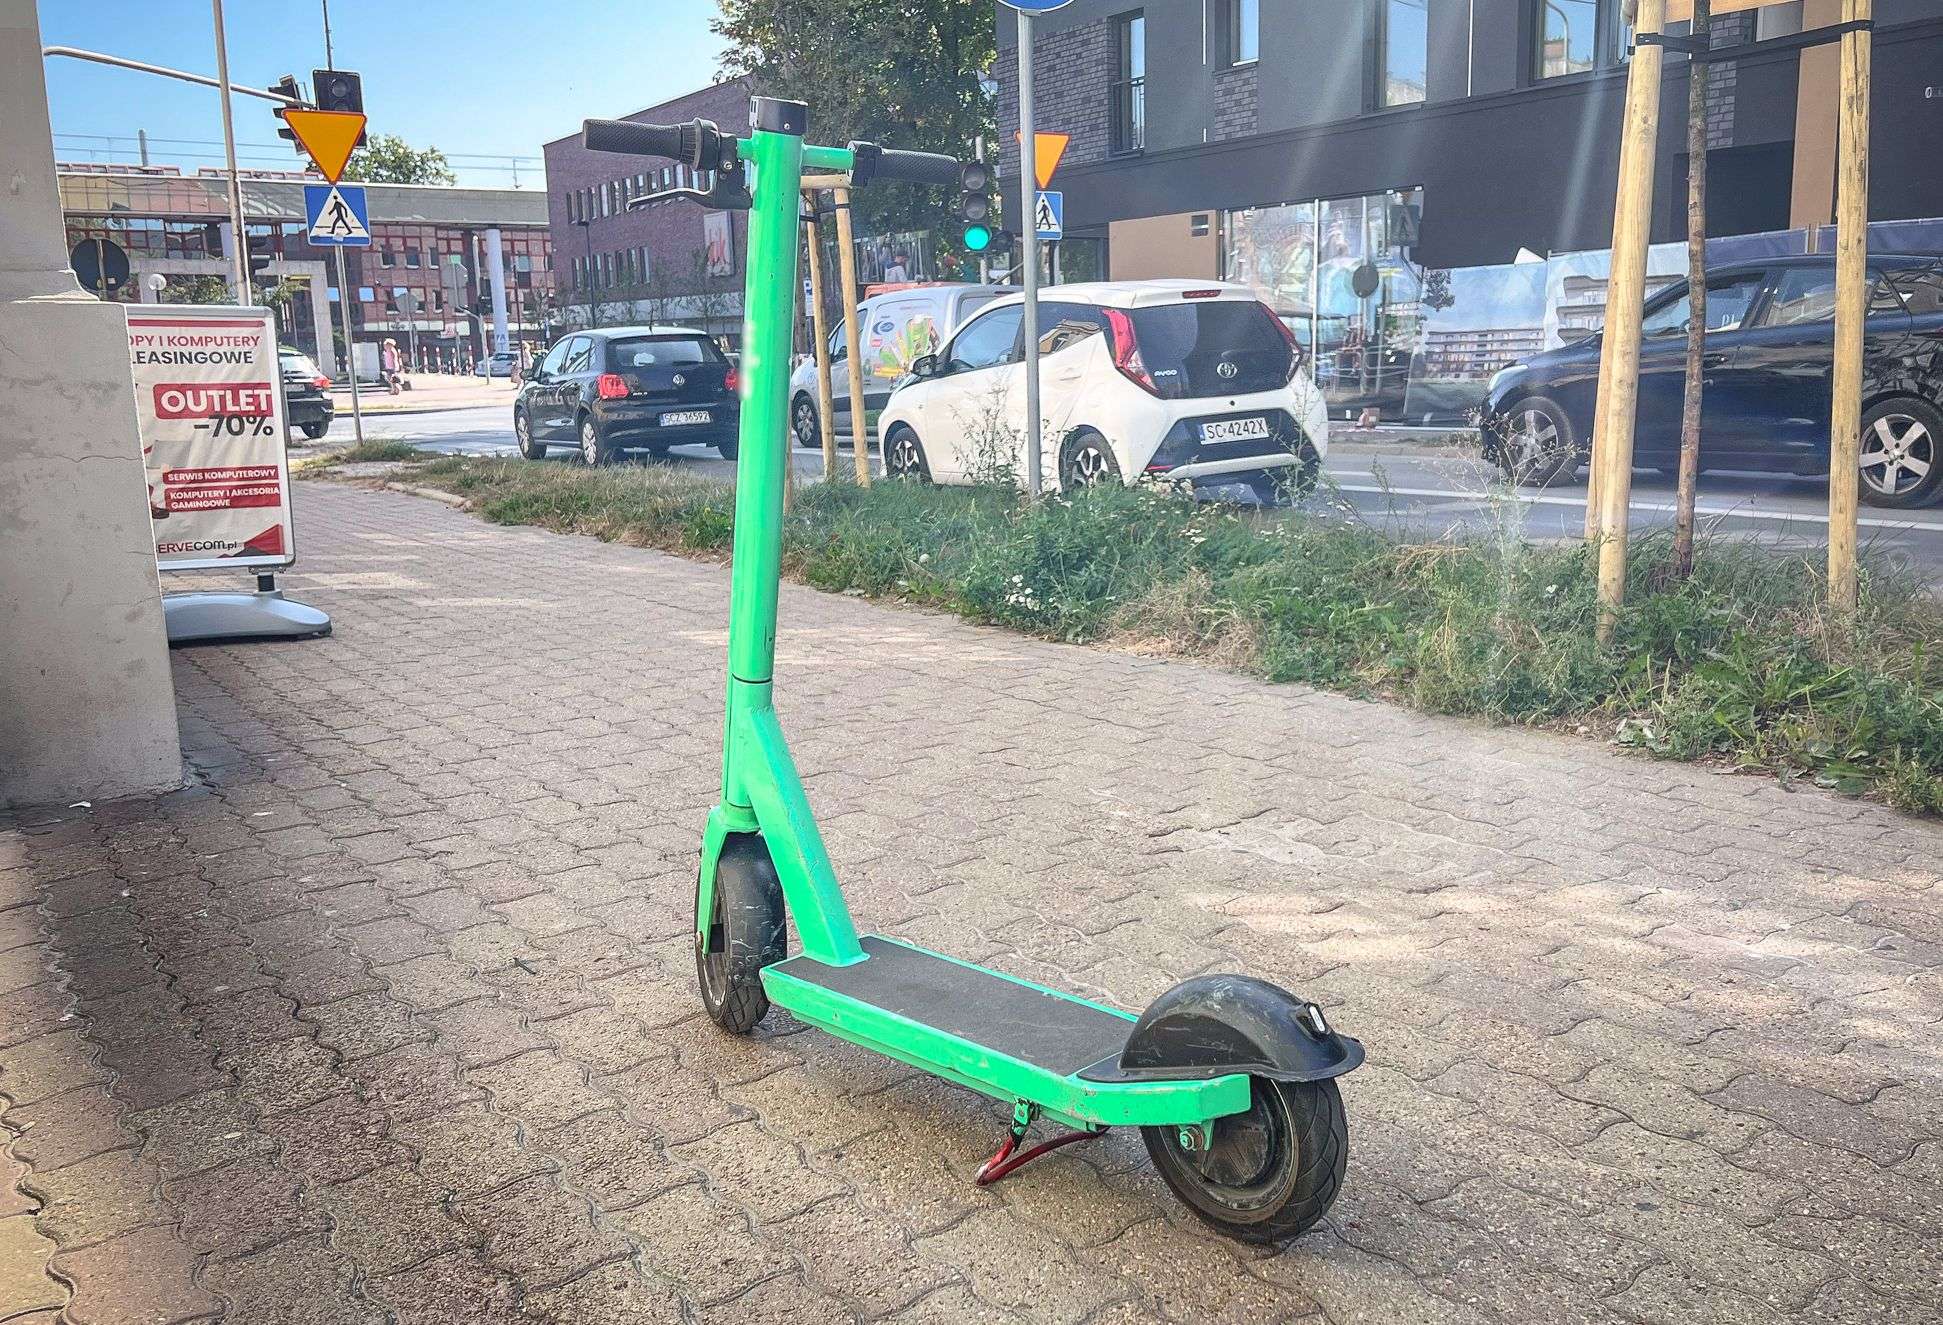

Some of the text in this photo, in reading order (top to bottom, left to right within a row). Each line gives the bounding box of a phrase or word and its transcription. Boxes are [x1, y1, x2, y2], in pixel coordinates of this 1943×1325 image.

[159, 335, 164, 347] I
[167, 335, 260, 347] KOMPUTERY
[160, 389, 272, 413] OUTLET
[1206, 418, 1266, 440] SC 4242X
[167, 468, 276, 482] SERWIS KOMPUTEROWY
[169, 488, 225, 500] KOMPUTERY
[231, 486, 280, 497] AKCESORIA
[170, 499, 231, 510] GAMINGOWE
